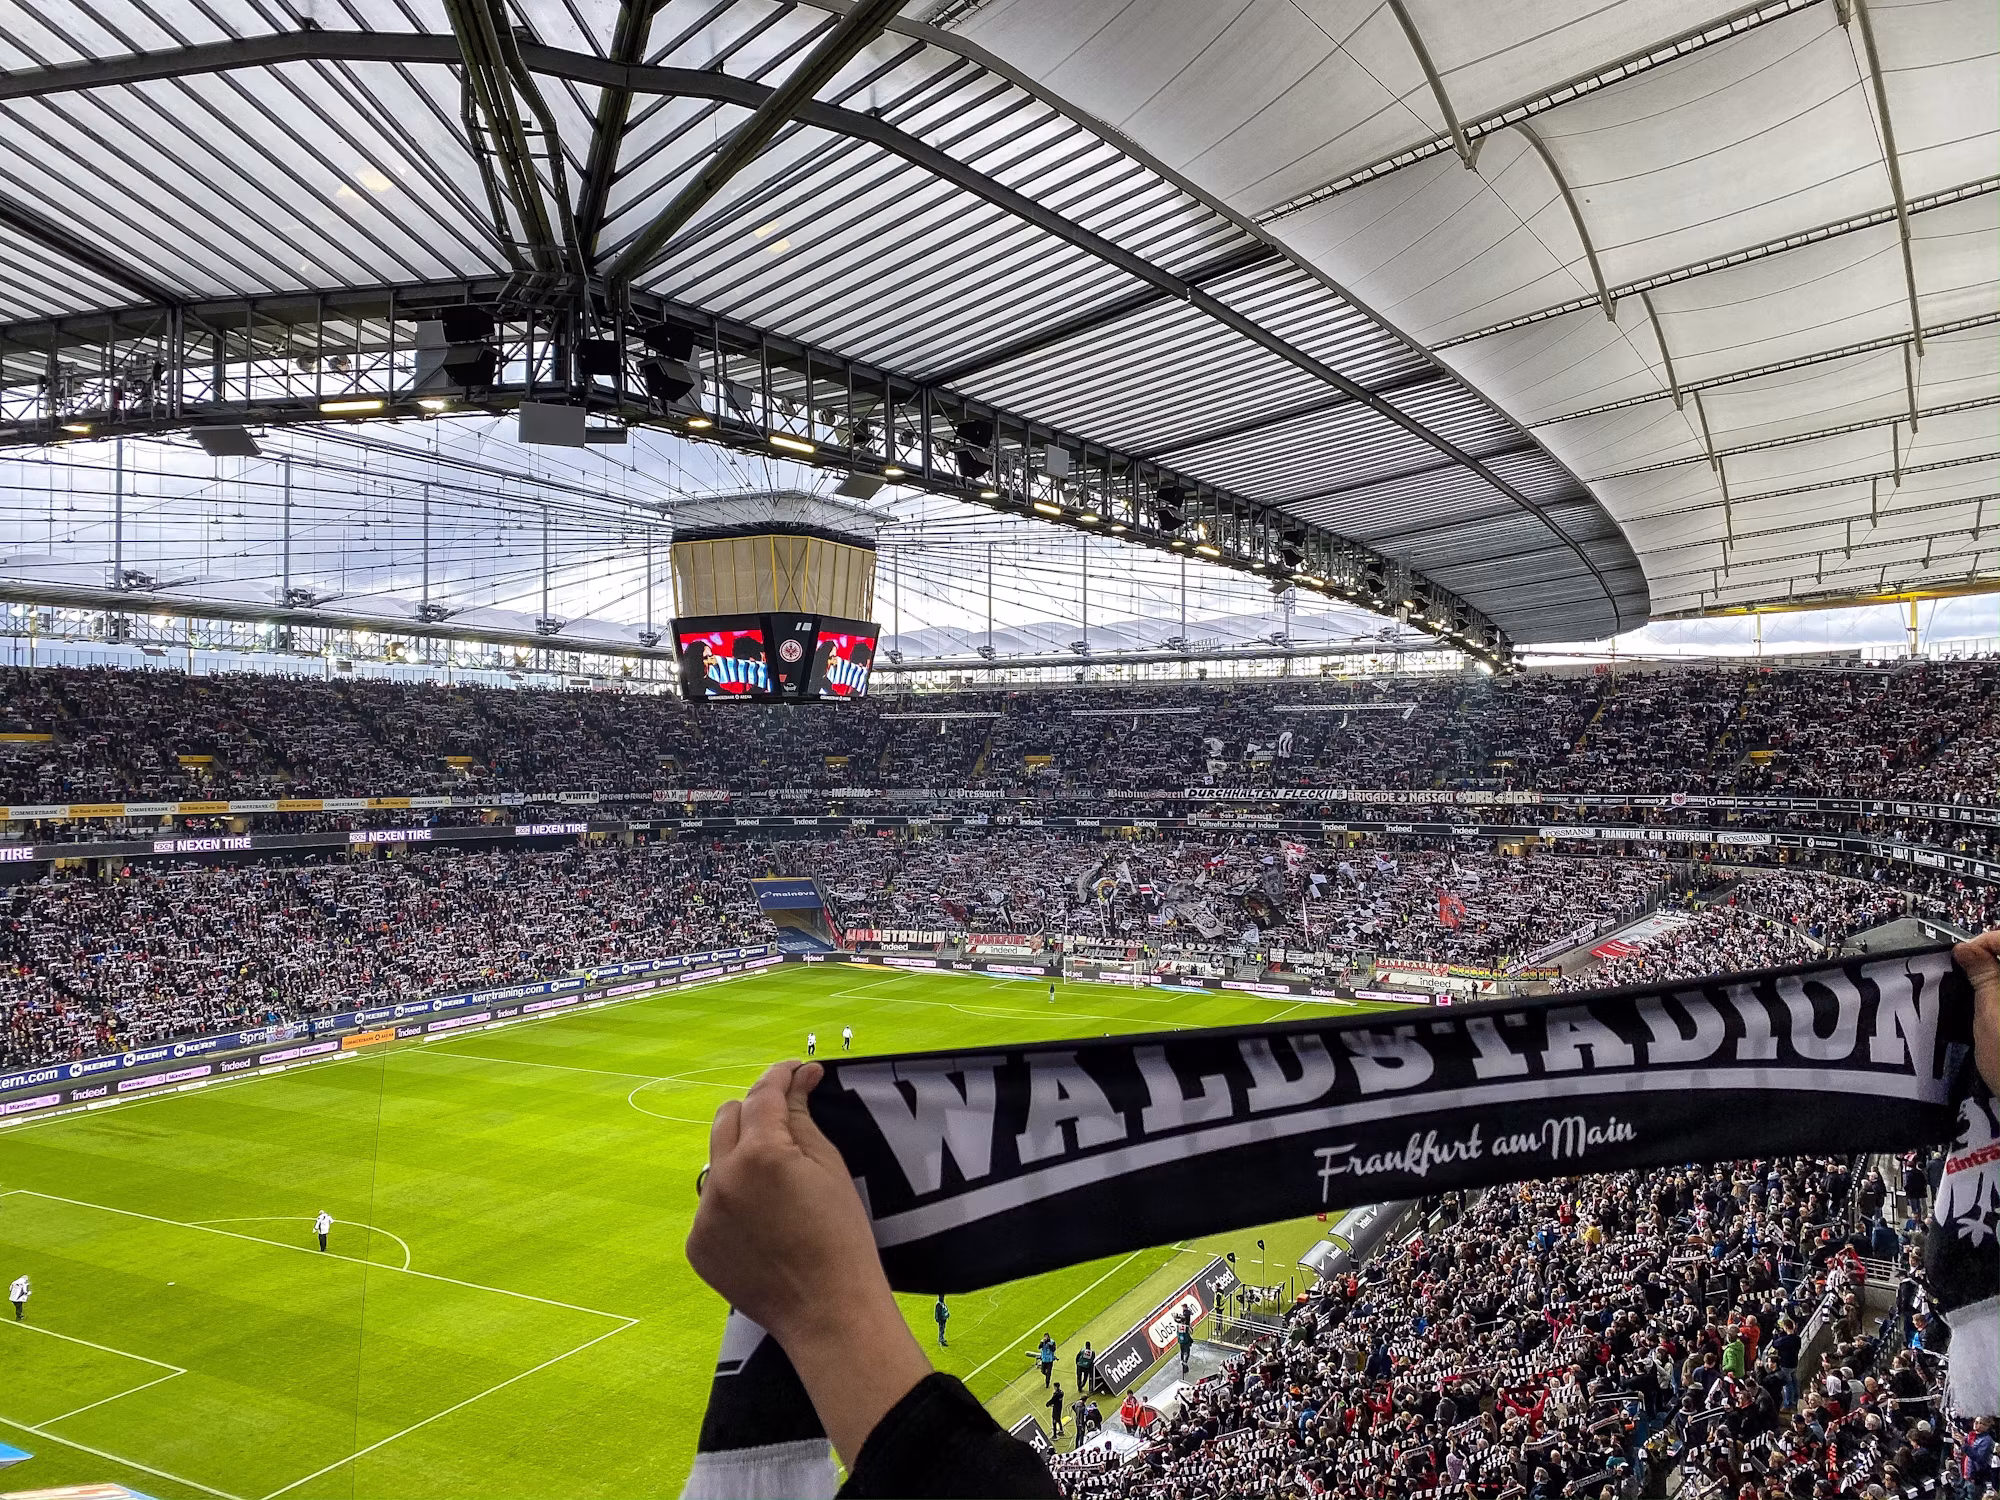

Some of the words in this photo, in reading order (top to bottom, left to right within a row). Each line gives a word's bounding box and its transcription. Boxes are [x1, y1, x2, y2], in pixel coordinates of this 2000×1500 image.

[532, 793, 558, 802] BLACK
[956, 788, 1005, 798] Presswerk
[1106, 788, 1149, 799] Binding
[1188, 788, 1278, 798] DURCHHALTEN
[1348, 792, 1395, 803] BRIGADE
[1409, 792, 1454, 804] NASSAU
[628, 822, 651, 830] indeed
[680, 820, 703, 828] indeed
[735, 818, 759, 826] indeed
[907, 817, 931, 825] indeed
[1075, 818, 1099, 826] indeed
[1133, 819, 1157, 827] indeed
[532, 824, 565, 835] NEXEN
[566, 823, 588, 833] TIRE
[1320, 823, 1348, 831] indeed
[1384, 824, 1412, 832] indeed
[1450, 826, 1479, 835] indeed
[369, 831, 405, 842] NEXEN
[406, 829, 432, 840] TIRE
[1545, 828, 1590, 837] POSSMANN
[1601, 829, 1647, 840] FRANKFURT,
[1649, 831, 1663, 840] GIB
[1665, 831, 1712, 842] STÖFFSCHE!
[1724, 834, 1766, 843] POSSMANN
[177, 839, 220, 851] NEXEN
[222, 837, 252, 849] TIRE
[0, 847, 33, 861] TIRE
[846, 929, 946, 943] WALDSTADION
[968, 934, 1026, 945] FRANKFURT
[880, 942, 909, 951] indeed
[991, 946, 1018, 954] indeed
[718, 951, 737, 959] KERN
[802, 954, 824, 962] indeed
[850, 955, 869, 963] indeed
[629, 963, 649, 971] KERN
[660, 959, 680, 967] KERN
[727, 964, 742, 972] indeed
[952, 961, 972, 970] indeed
[1379, 958, 1440, 969] EINTRACHT
[598, 968, 619, 976] KERN
[1293, 964, 1326, 976] indeed
[559, 980, 581, 989] KERN
[659, 977, 677, 986] indeed
[1180, 977, 1204, 987] indeed
[1420, 977, 1451, 988] indeed
[583, 991, 602, 1001] indeed
[1309, 987, 1335, 997] indeed
[442, 998, 466, 1008] KERN
[404, 1003, 429, 1014] KERN
[496, 1008, 518, 1018] indeed
[365, 1011, 390, 1021] KERN
[396, 1026, 421, 1038] indeed
[239, 1032, 266, 1045] Spra
[186, 1040, 217, 1053] KERN
[136, 1050, 168, 1062] KERN
[84, 1060, 117, 1072] KERN
[220, 1058, 251, 1072] indeed
[837, 950, 1953, 1197] WALDSTADION
[70, 1085, 107, 1101] indeed
[1313, 1122, 1483, 1203] Frankfurt
[1492, 1132, 1542, 1156] am
[1541, 1115, 1638, 1160] Main
[1155, 1322, 1177, 1343] Jobs
[1104, 1347, 1143, 1384] indeed
